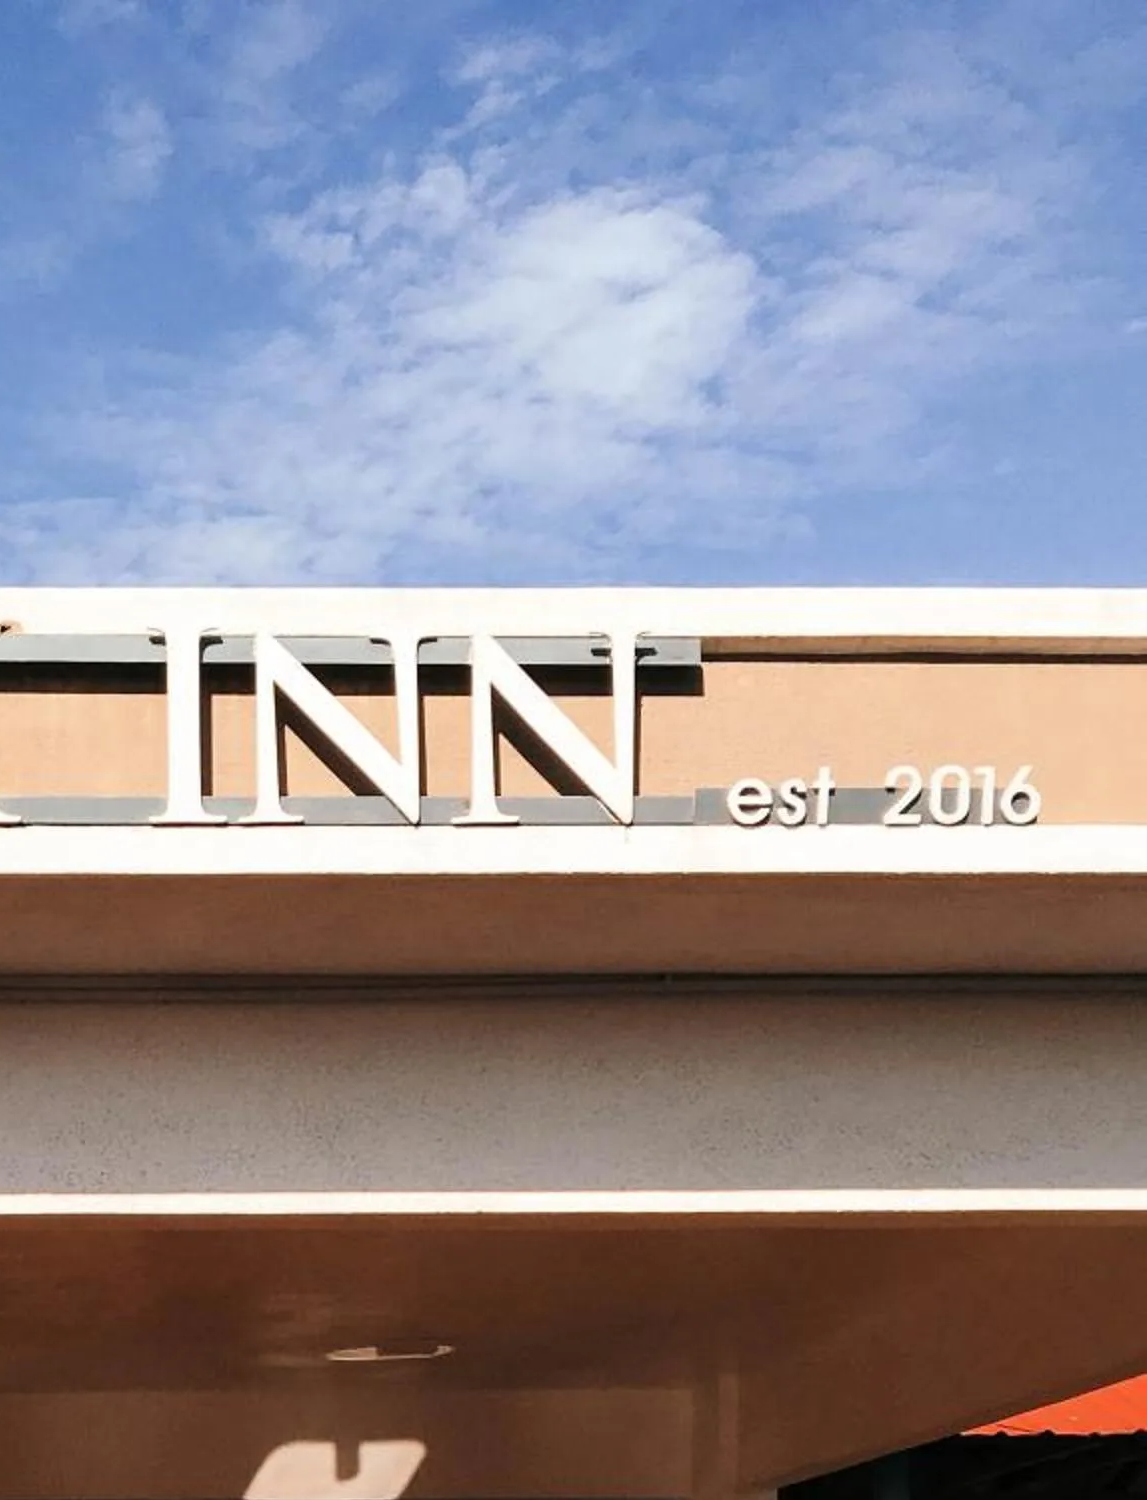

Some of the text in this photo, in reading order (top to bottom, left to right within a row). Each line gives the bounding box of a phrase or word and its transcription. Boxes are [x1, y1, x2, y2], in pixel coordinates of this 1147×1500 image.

[148, 628, 654, 826] INN
[728, 766, 835, 827] est
[883, 765, 1043, 828] 2016
